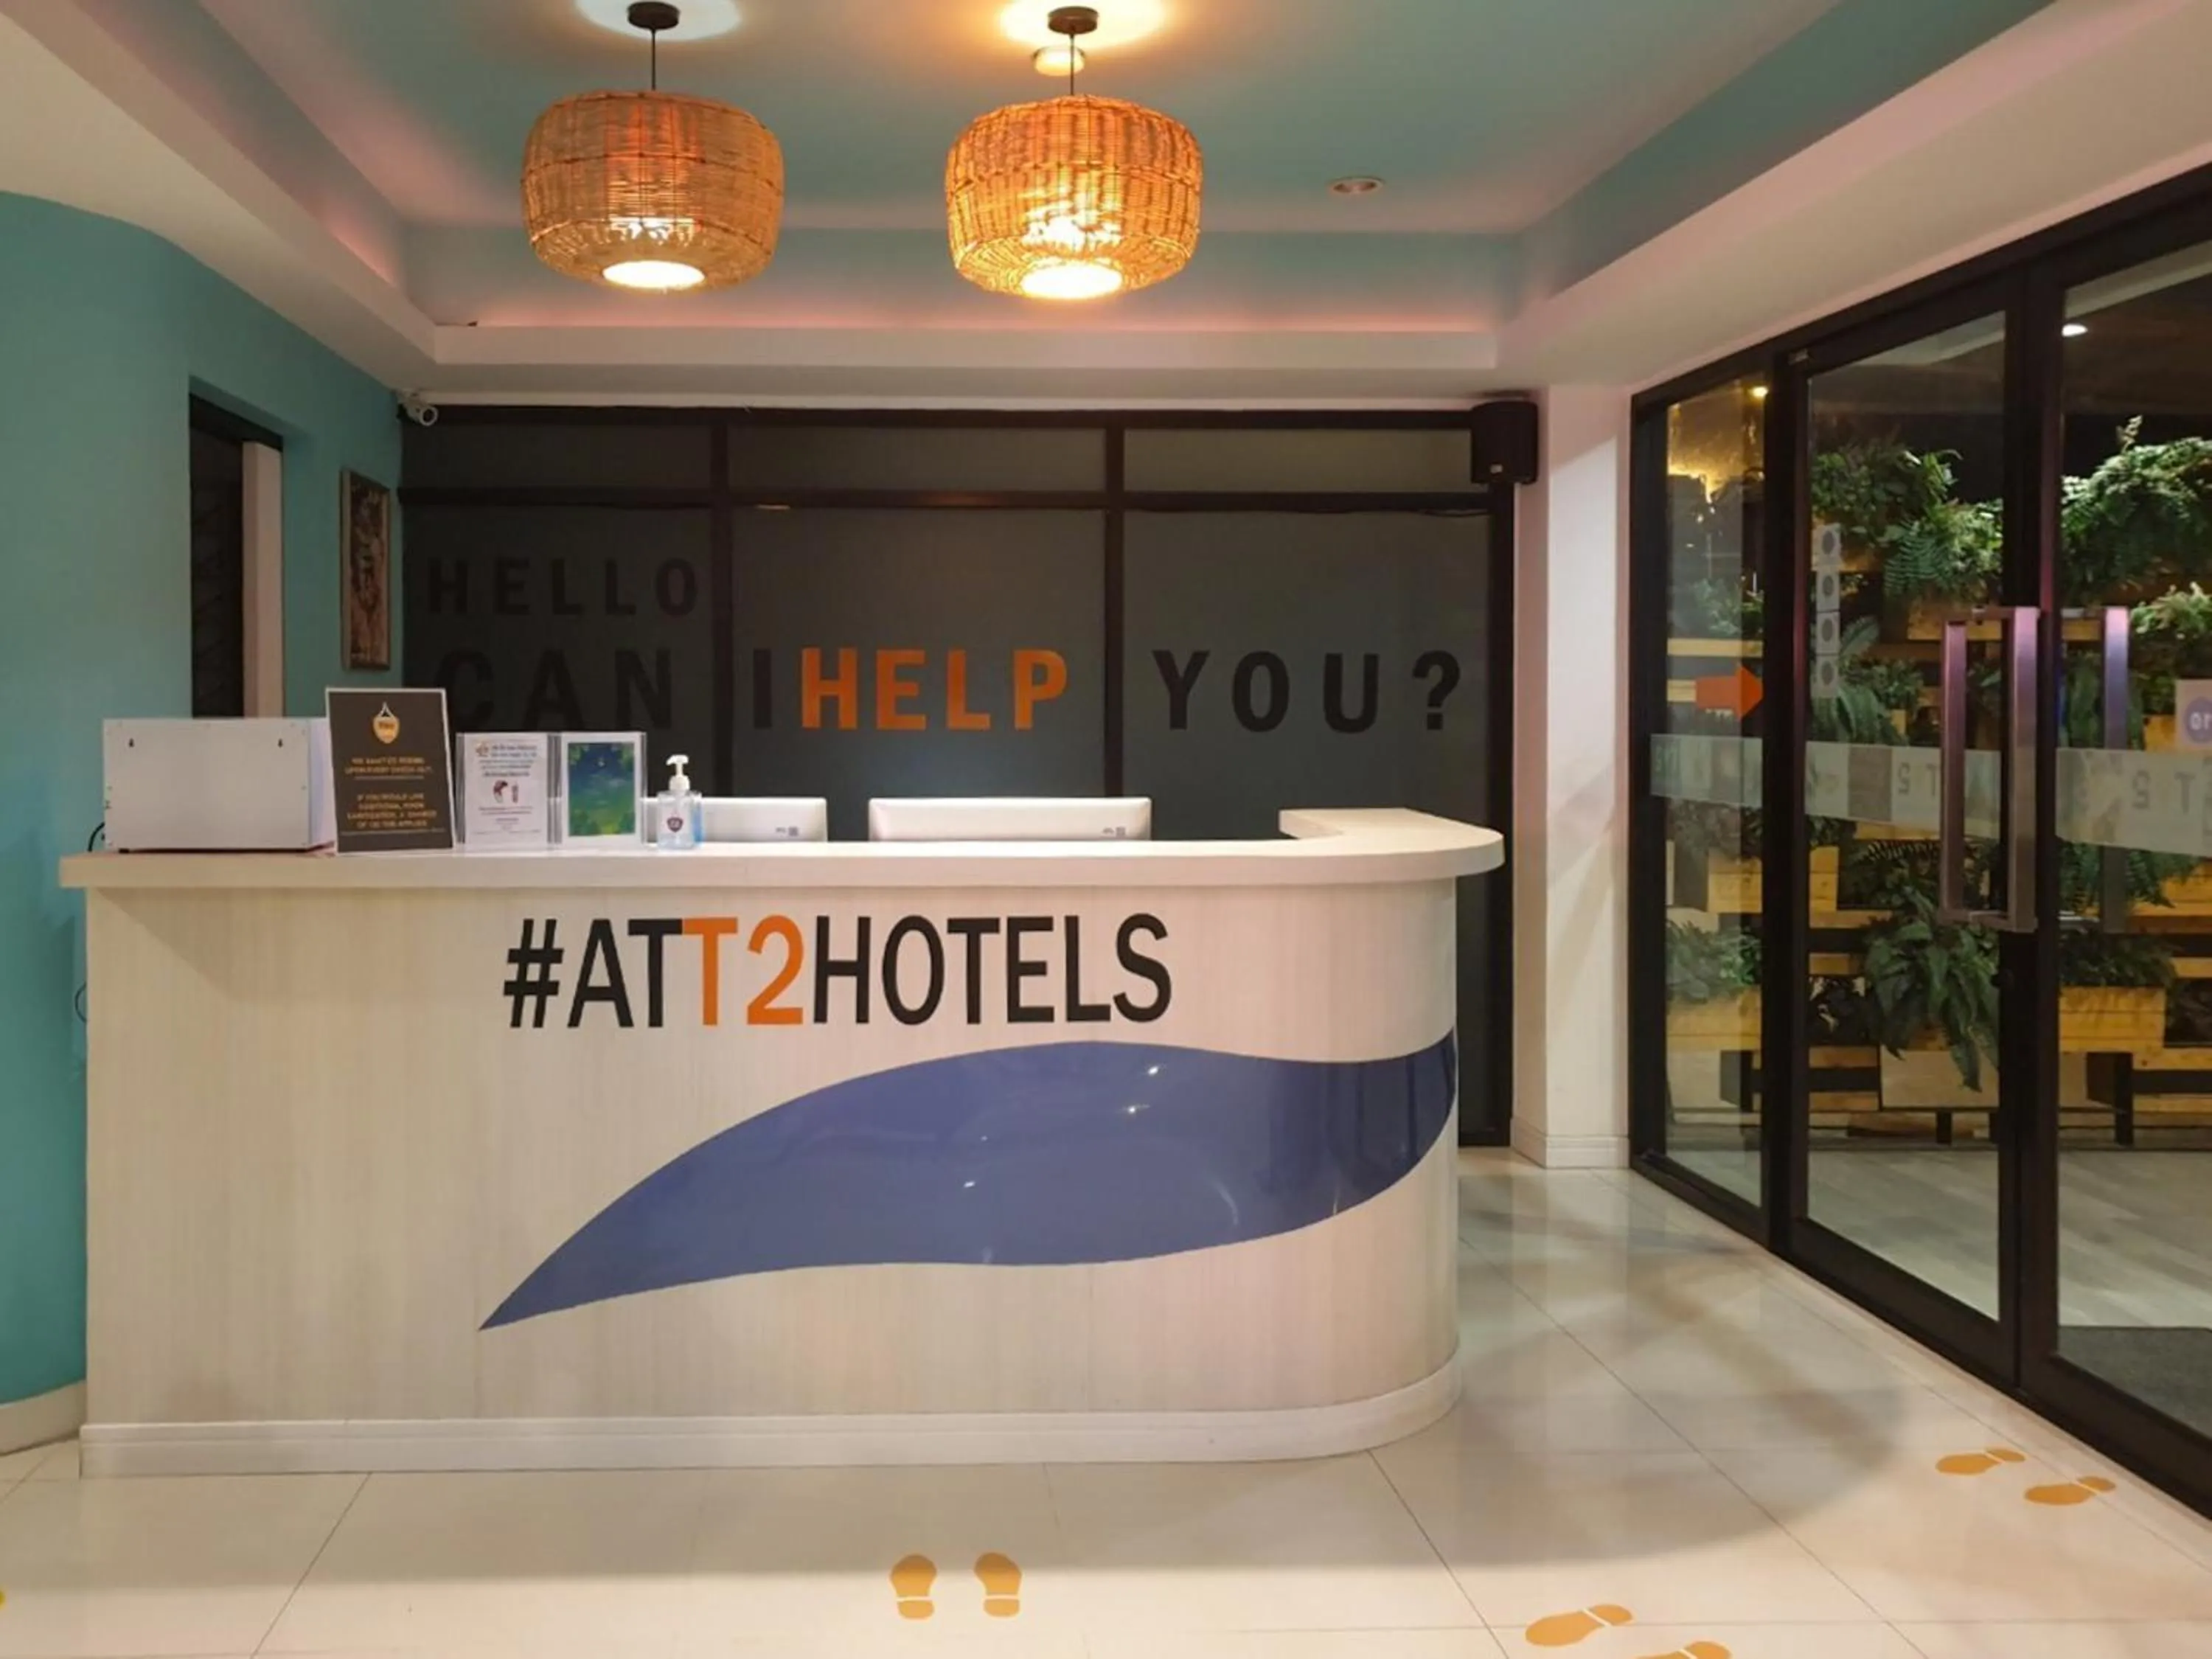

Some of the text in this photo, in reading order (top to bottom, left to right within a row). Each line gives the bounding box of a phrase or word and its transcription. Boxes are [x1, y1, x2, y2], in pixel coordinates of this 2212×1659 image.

[428, 557, 699, 616] HELLO
[434, 646, 1461, 733] CAN I HELP YOU?
[503, 913, 1172, 1029] #ATT2HOTELS
